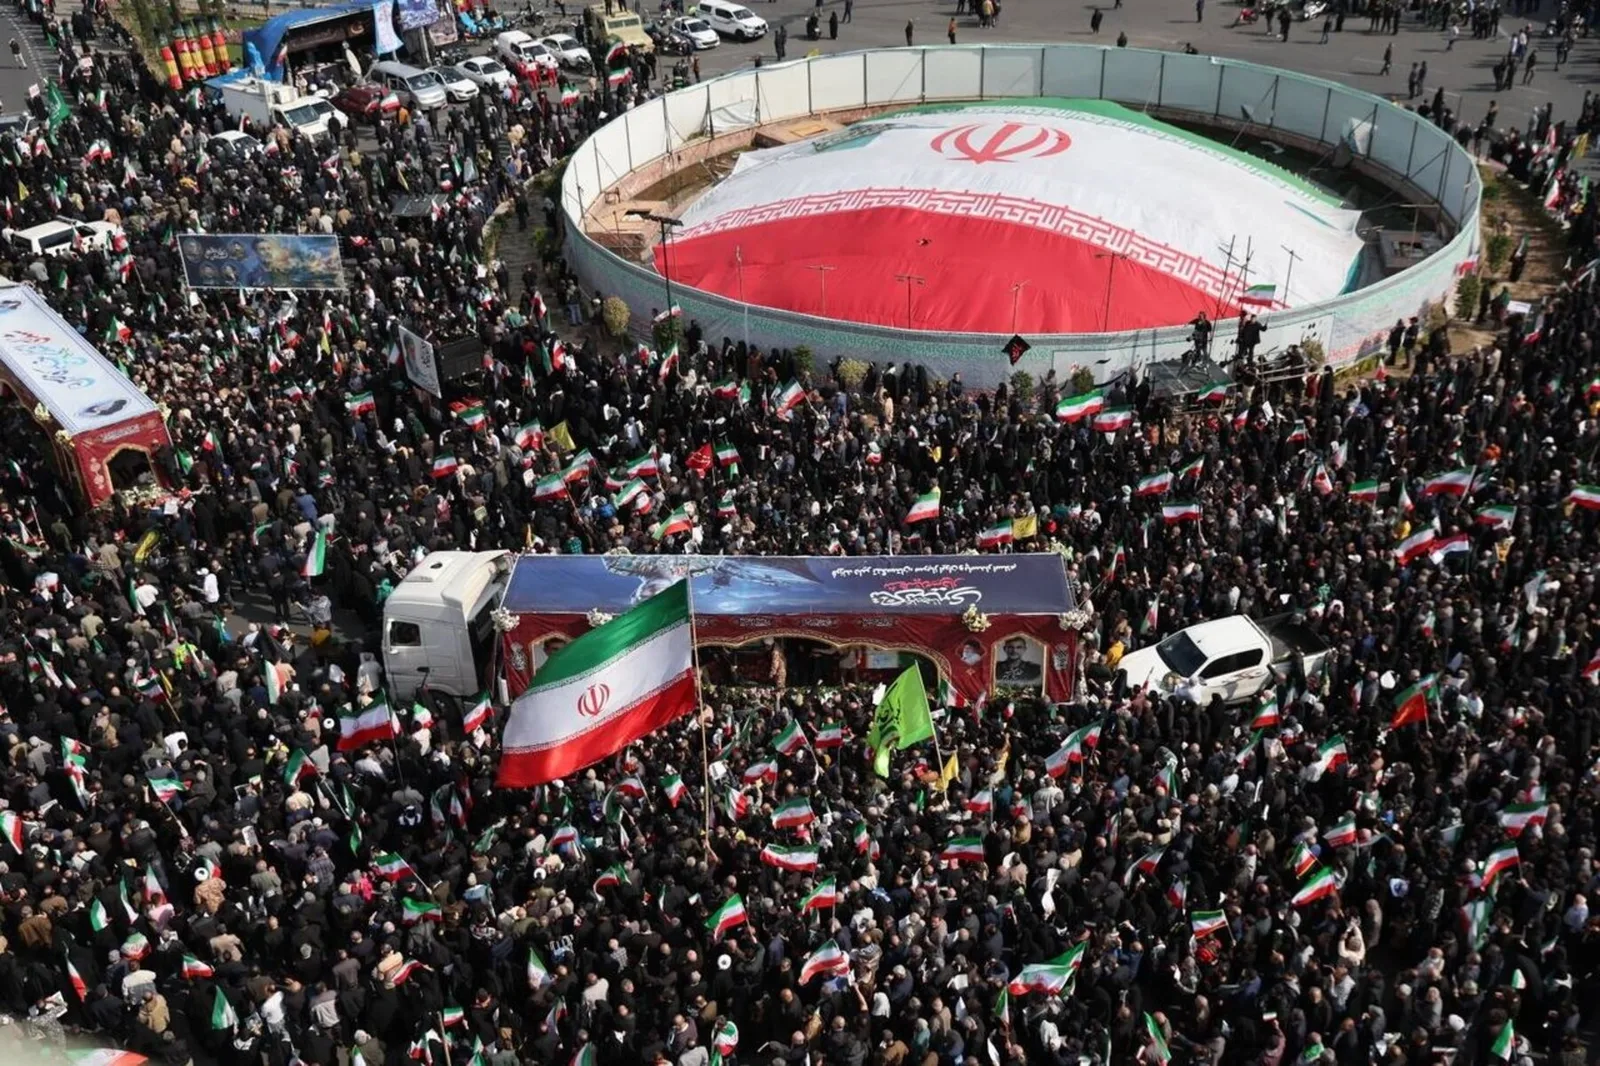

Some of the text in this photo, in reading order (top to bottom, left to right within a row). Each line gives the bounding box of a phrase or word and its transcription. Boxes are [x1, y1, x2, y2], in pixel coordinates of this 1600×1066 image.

[940, 564, 958, 574] ایران
[965, 563, 992, 573] پاسدار
[993, 564, 1016, 572] اسلام
